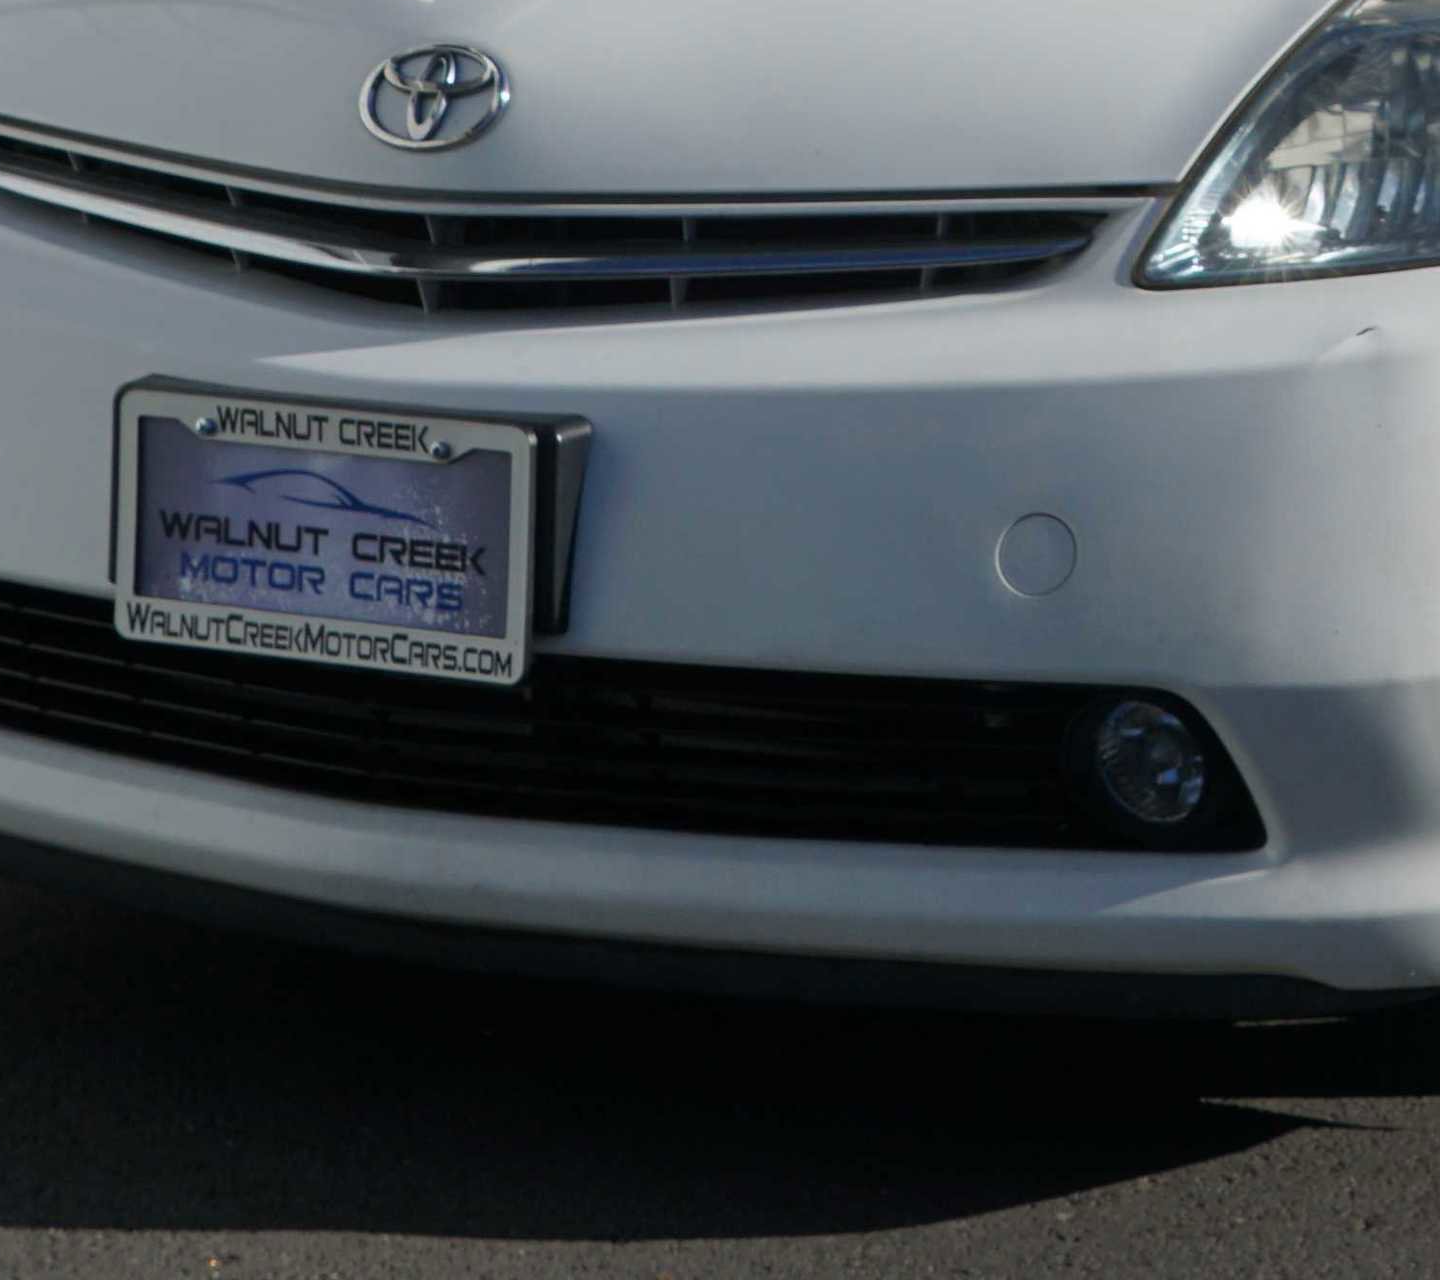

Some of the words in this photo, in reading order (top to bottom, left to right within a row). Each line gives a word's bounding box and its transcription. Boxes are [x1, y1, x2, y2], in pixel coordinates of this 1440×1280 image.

[216, 405, 328, 444] WALNUT
[338, 418, 430, 453] CREEK
[160, 509, 329, 556] WALNUT
[351, 533, 487, 577] CREEK
[179, 550, 326, 595] MOTOR
[348, 571, 463, 612] CARS
